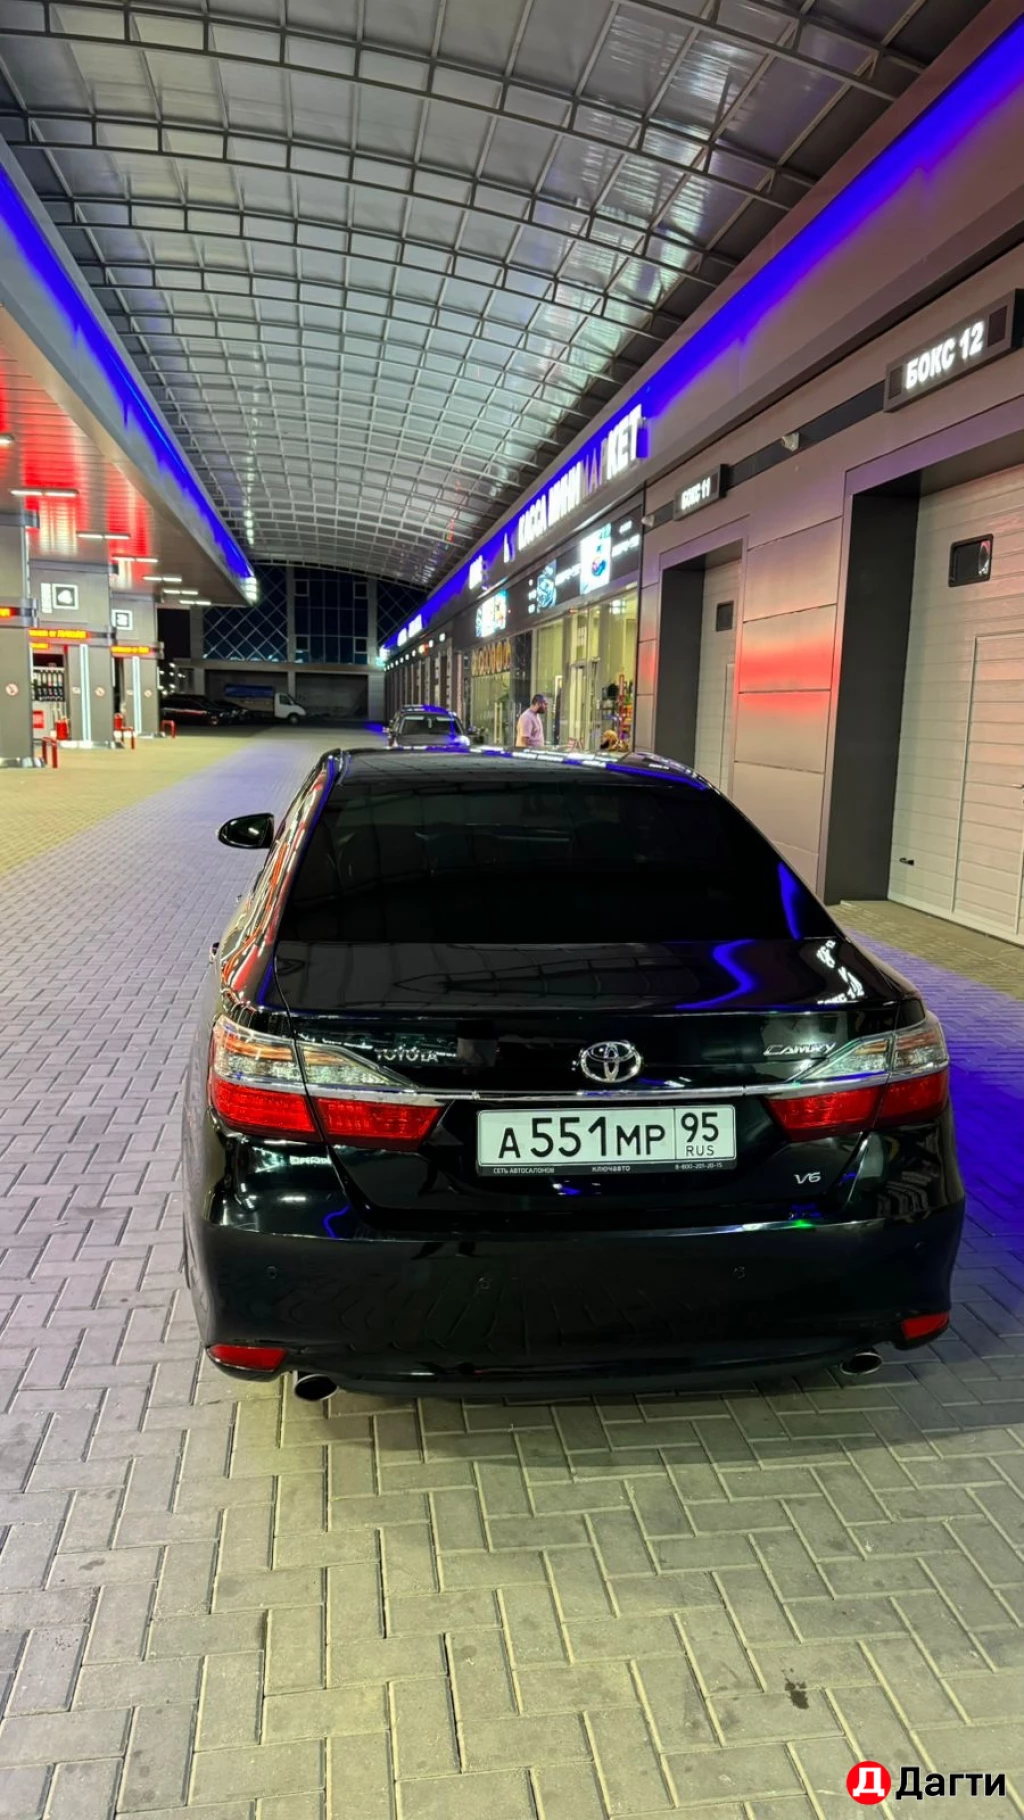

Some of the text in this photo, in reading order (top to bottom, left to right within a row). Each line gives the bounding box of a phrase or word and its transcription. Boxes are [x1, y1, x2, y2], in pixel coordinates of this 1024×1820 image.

[906, 319, 985, 390] БОКС 12
[681, 476, 711, 510] БОКС 11
[374, 1047, 439, 1062] TOYOTA
[680, 1112, 719, 1143] 95
[685, 1145, 715, 1157] RUS
[794, 1171, 821, 1184] V6
